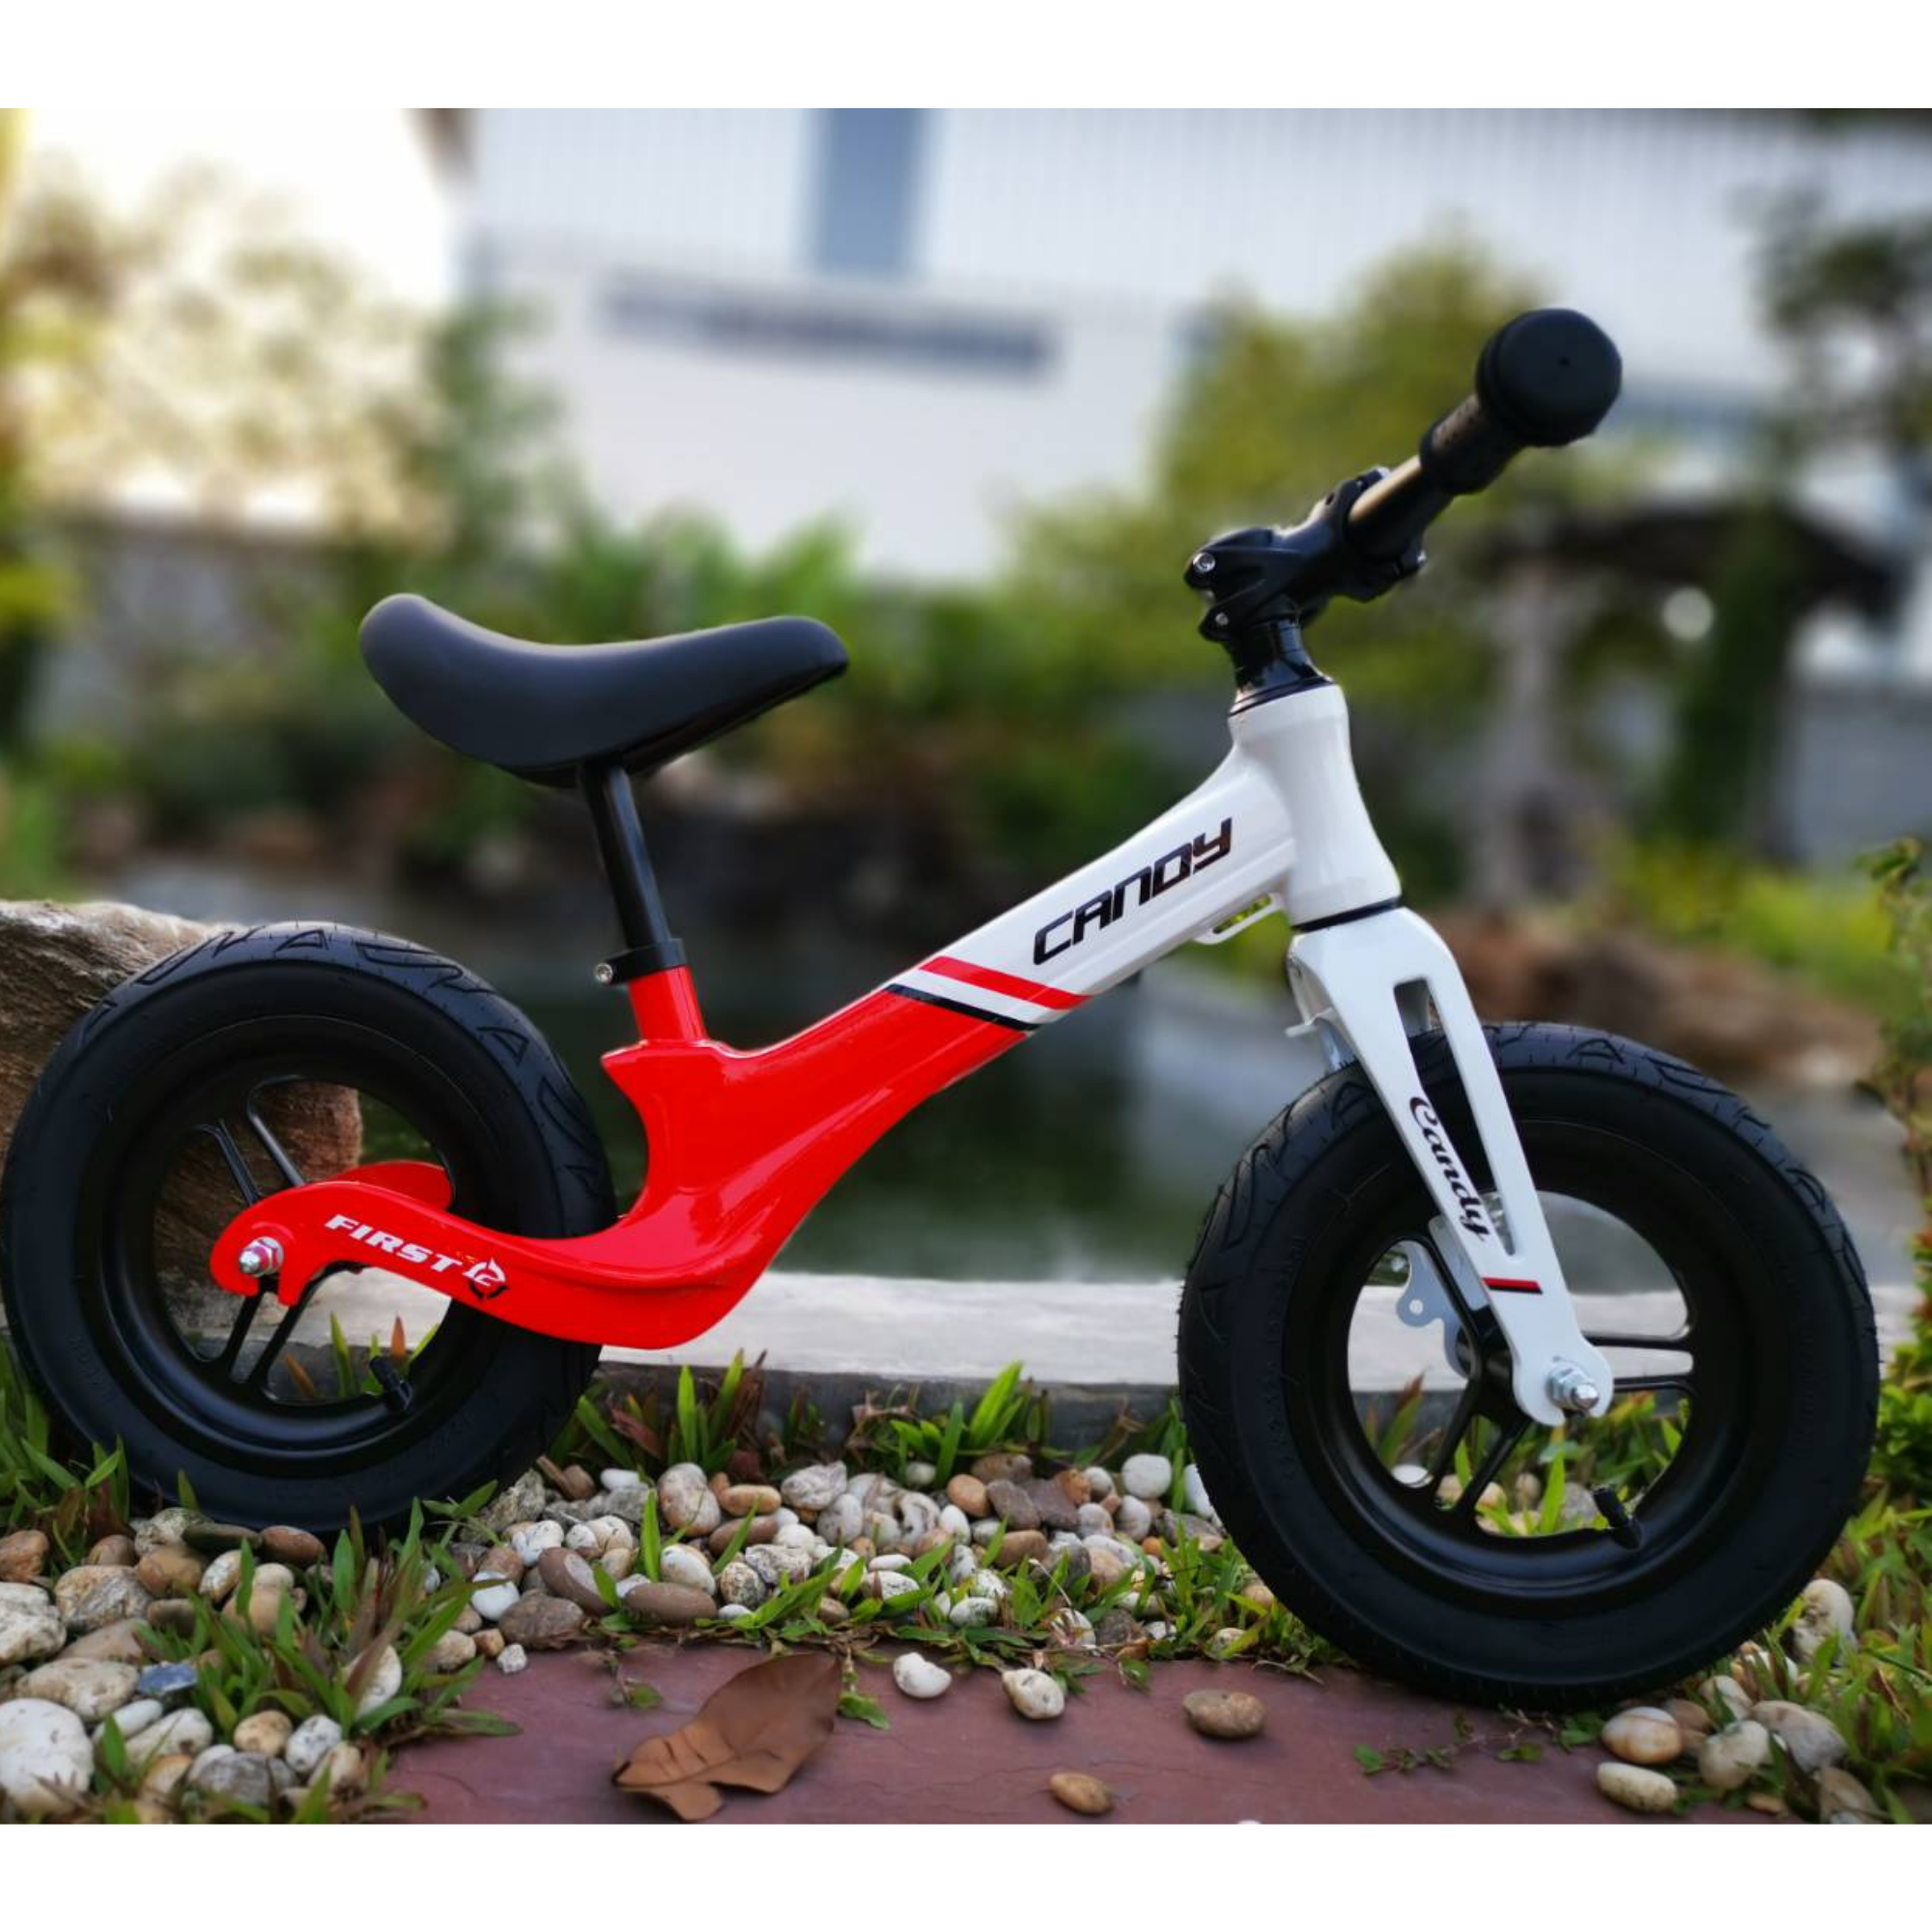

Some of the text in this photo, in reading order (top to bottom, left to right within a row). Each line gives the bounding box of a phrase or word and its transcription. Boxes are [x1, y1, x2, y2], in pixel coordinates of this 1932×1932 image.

[1034, 817, 1233, 966] CANDY
[1409, 1097, 1491, 1242] Candy
[325, 1213, 463, 1273] FIRST
